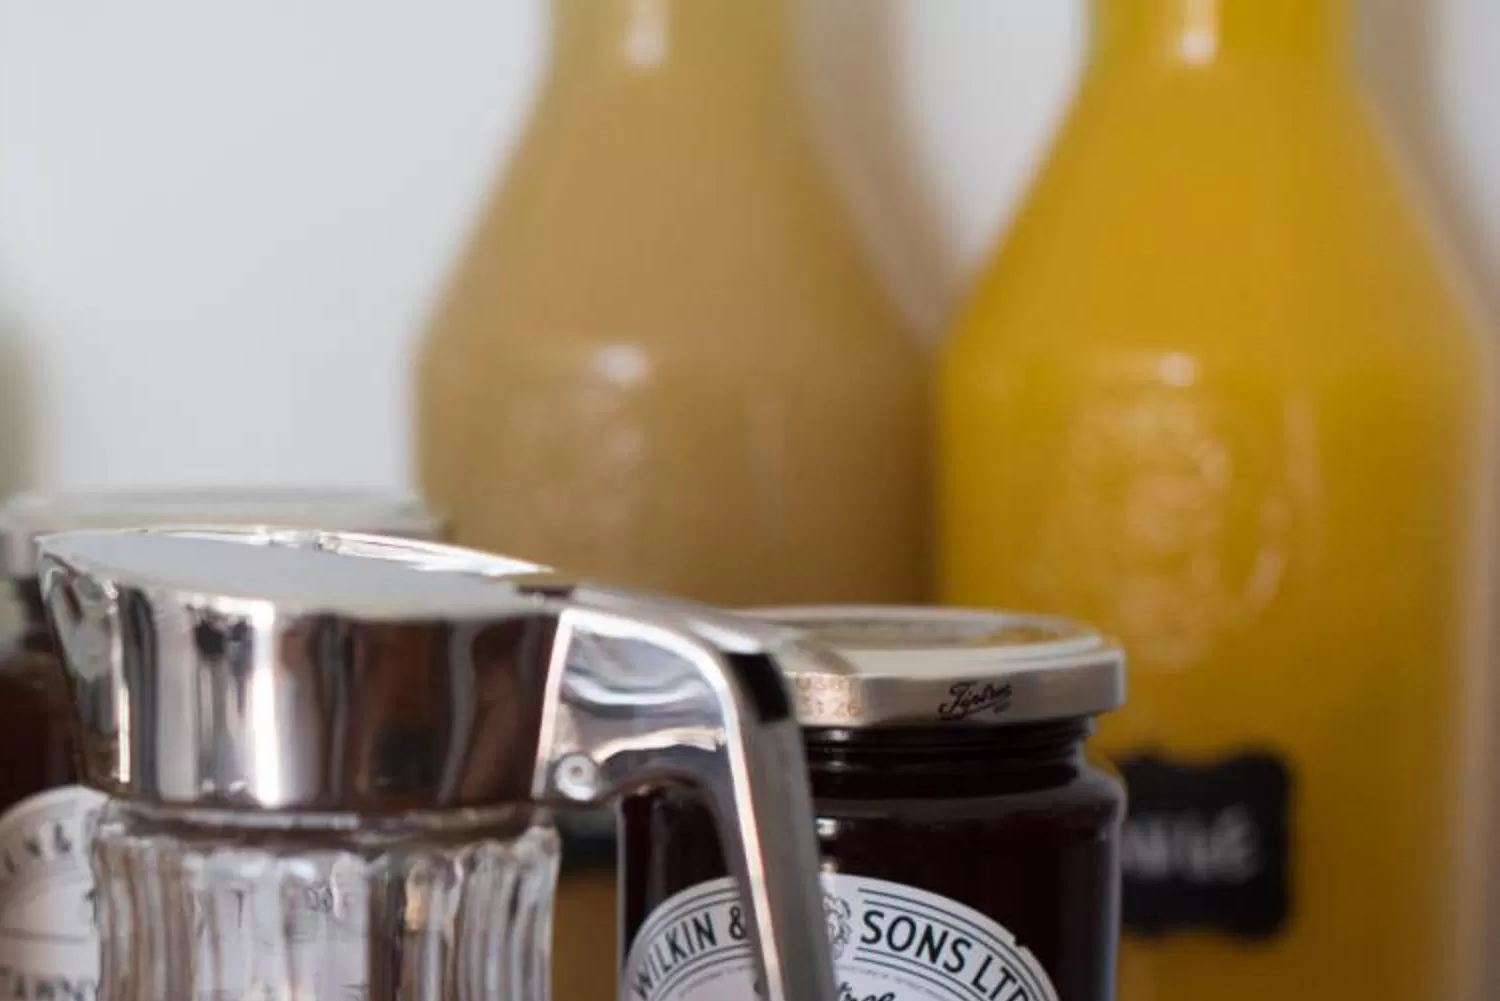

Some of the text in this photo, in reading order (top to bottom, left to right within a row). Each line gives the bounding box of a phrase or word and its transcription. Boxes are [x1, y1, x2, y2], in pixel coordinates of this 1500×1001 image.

[632, 917, 716, 1001] WILKIN
[728, 906, 748, 940] &
[860, 910, 972, 975] SONS
